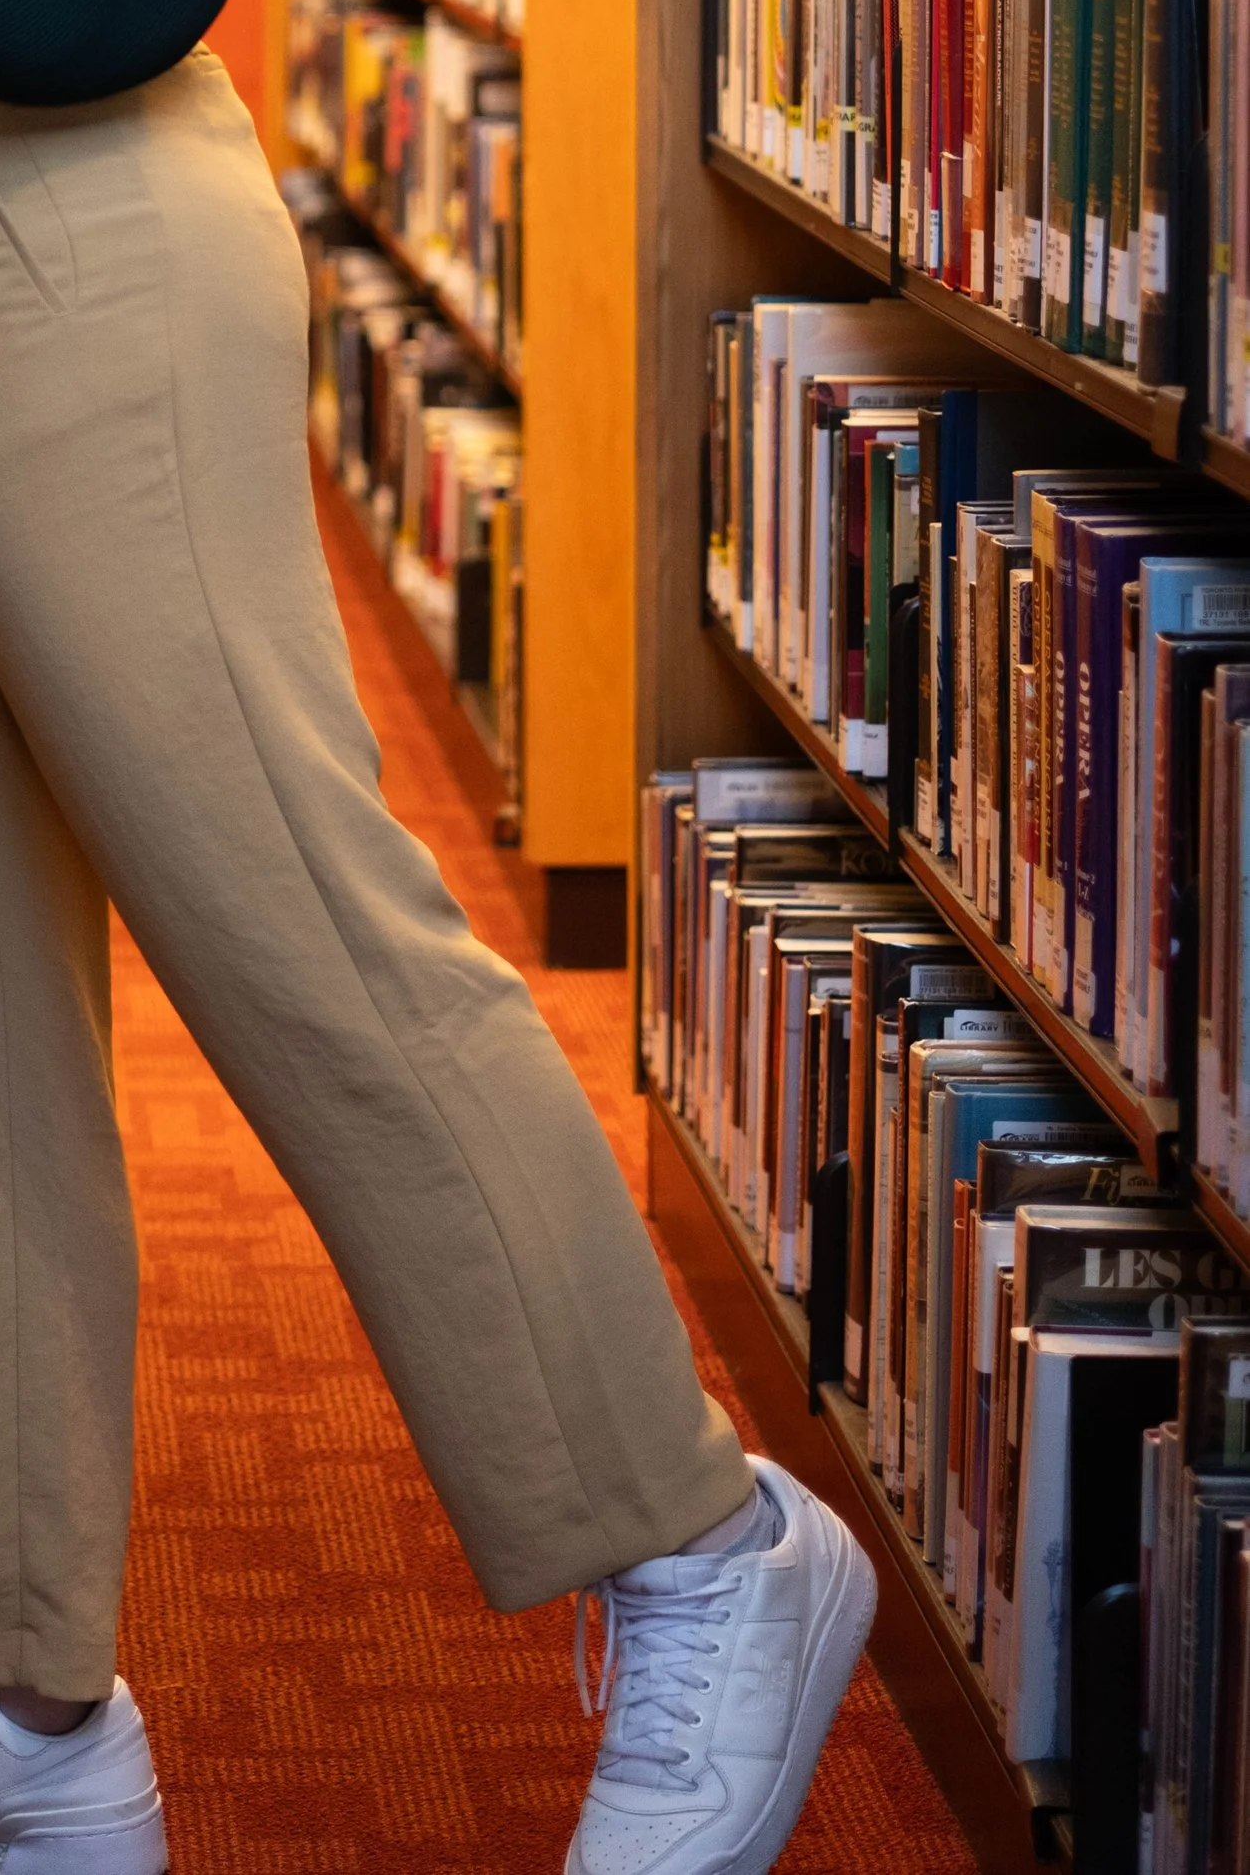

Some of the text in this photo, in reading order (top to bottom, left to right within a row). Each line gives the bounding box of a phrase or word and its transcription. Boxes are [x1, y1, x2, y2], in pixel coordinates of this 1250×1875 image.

[1054, 650, 1065, 786] OPERA
[1078, 662, 1090, 801] OPERA
[1080, 1247, 1183, 1289] LES
